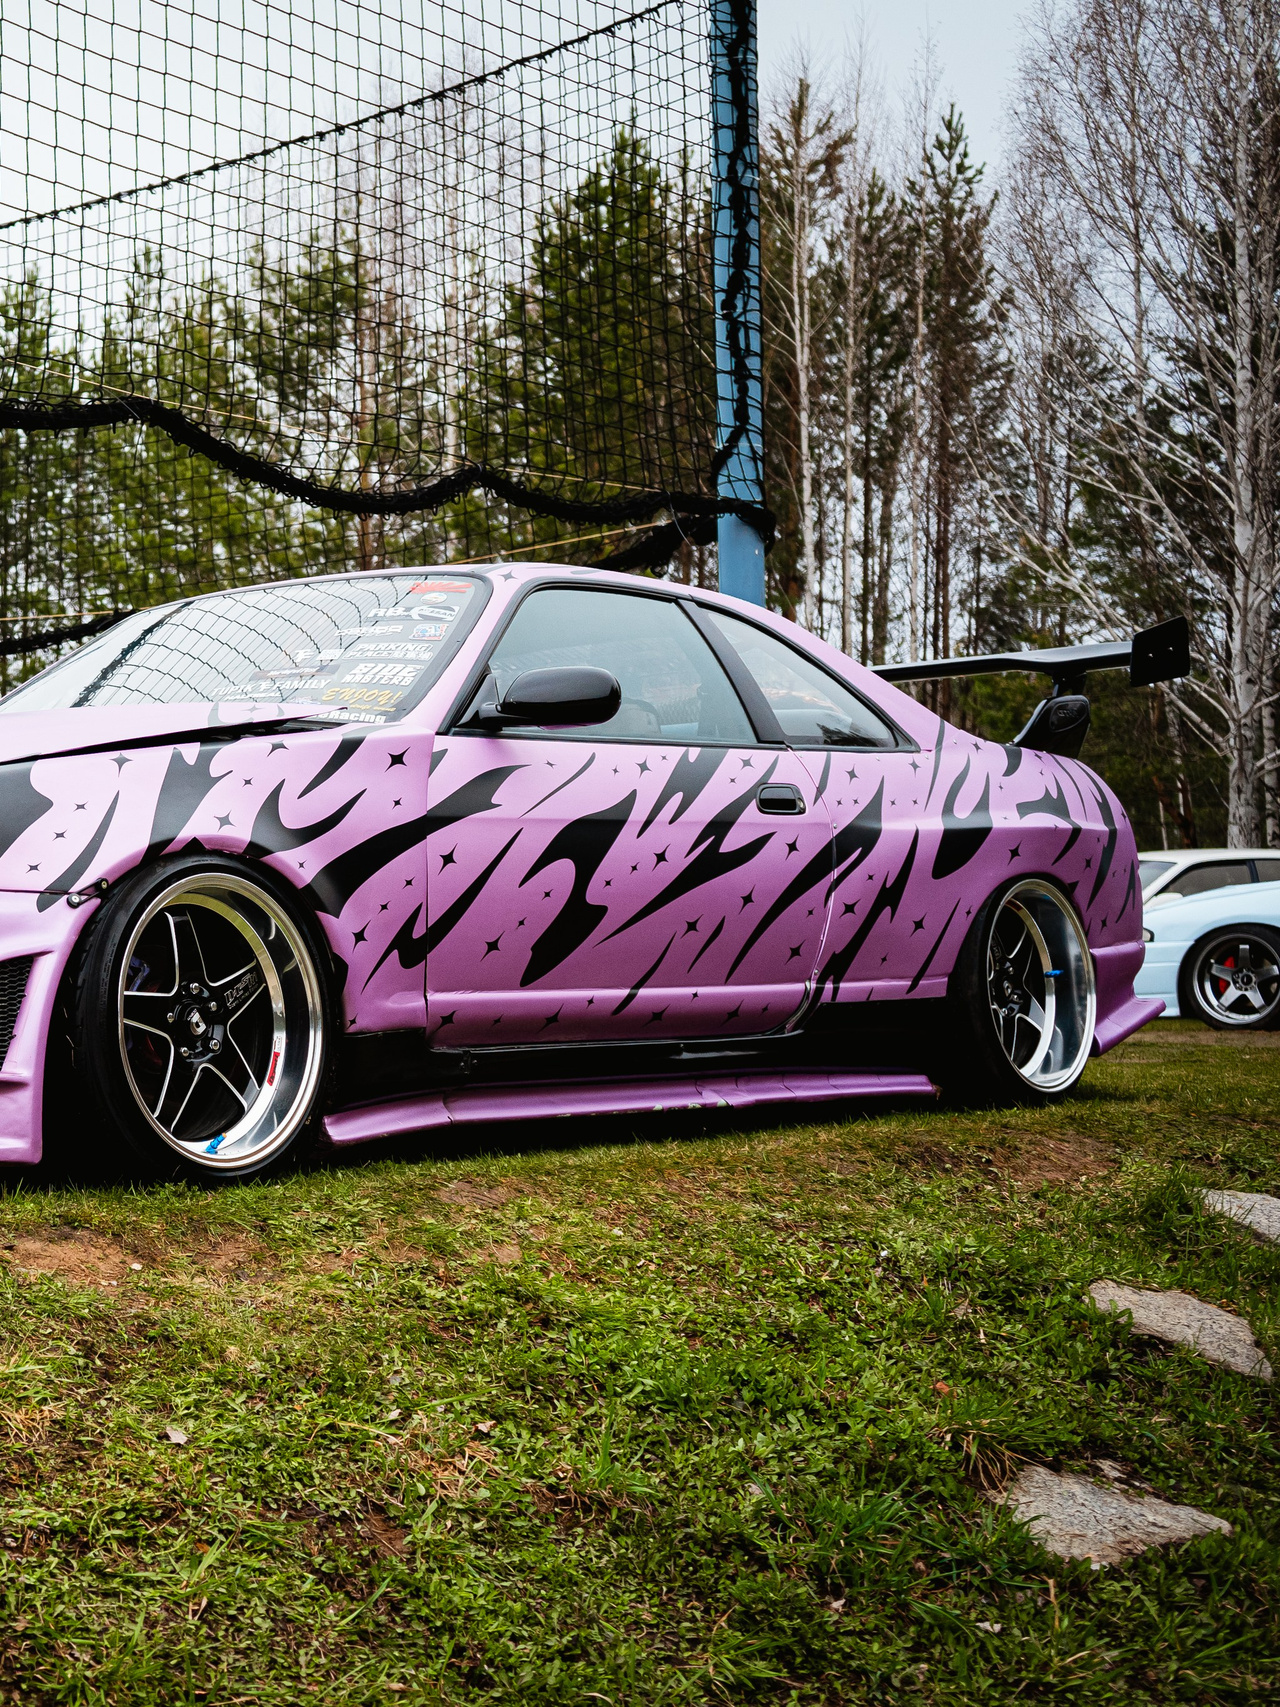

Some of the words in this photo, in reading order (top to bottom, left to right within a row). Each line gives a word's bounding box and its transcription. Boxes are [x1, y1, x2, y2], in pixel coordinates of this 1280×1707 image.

[355, 642, 428, 652] PARKING
[272, 679, 331, 691] FAMILY
[321, 687, 402, 706] ENJOY!
